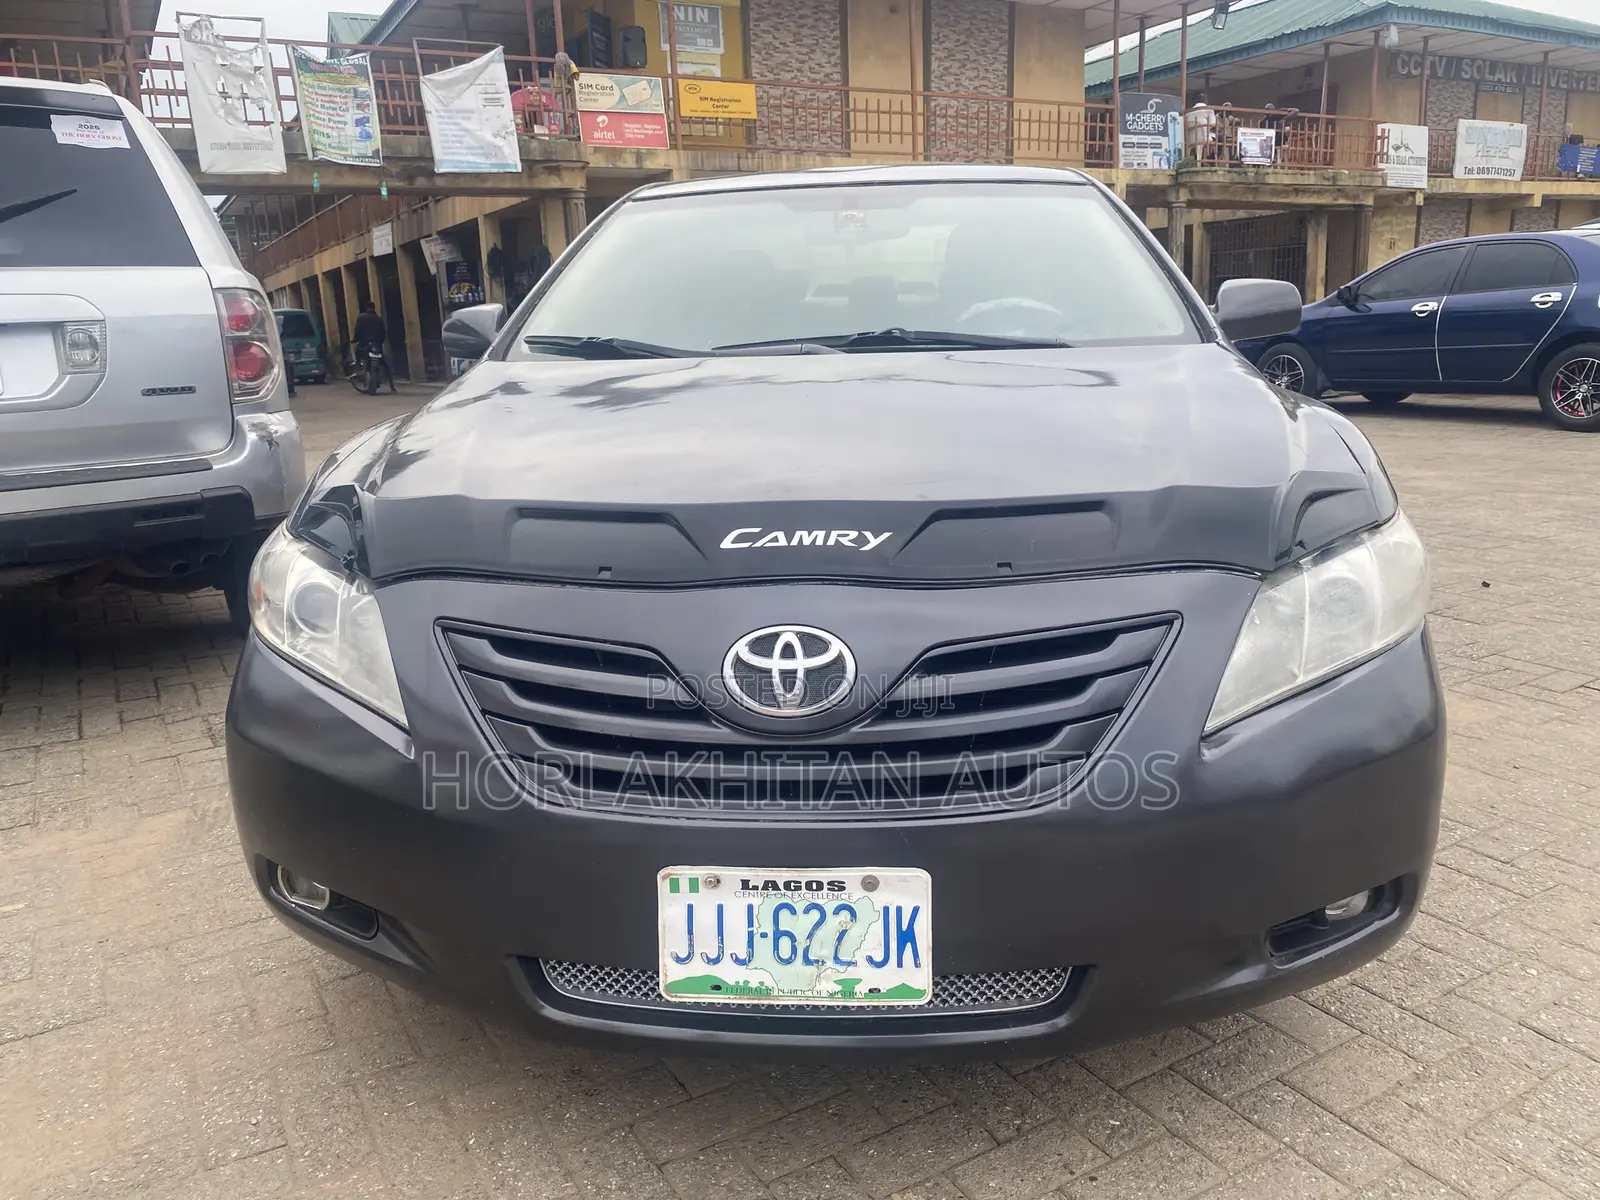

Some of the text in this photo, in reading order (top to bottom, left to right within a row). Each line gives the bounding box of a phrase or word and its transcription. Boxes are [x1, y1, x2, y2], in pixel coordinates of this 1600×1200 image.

[675, 5, 709, 23] NIN
[1396, 54, 1447, 77] CCTV
[1461, 59, 1518, 84] SOLAR
[595, 84, 614, 92] Card
[579, 90, 615, 98] Registration
[1125, 113, 1166, 123] M-CHERRY
[1126, 121, 1164, 131] GADGETS
[593, 128, 616, 140] airtel
[1464, 166, 1475, 175] Tel:
[719, 527, 893, 551] CAMRY
[740, 879, 846, 892] LAGOS
[734, 891, 854, 900] CENTRE OF EXCELLENCE
[725, 986, 764, 995] FEDERAL
[812, 989, 823, 997] OF
[826, 990, 864, 998] NIGERIA
